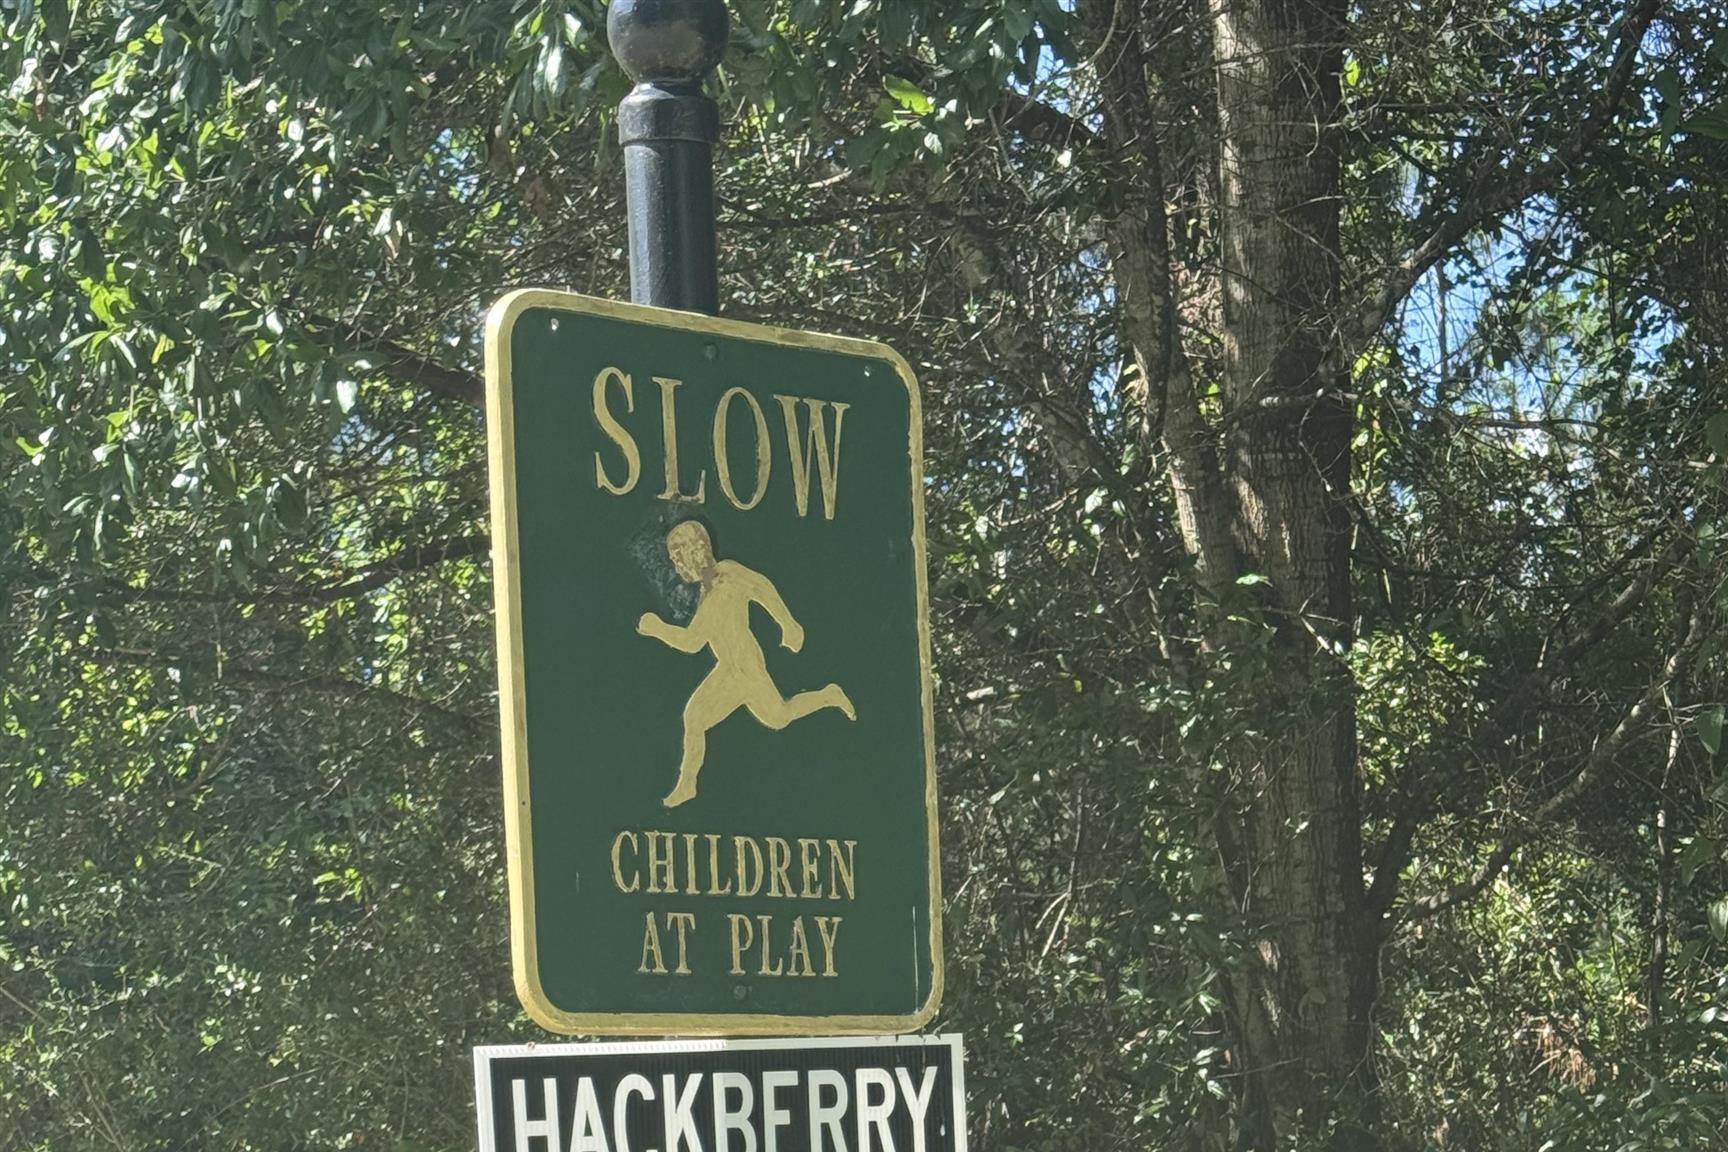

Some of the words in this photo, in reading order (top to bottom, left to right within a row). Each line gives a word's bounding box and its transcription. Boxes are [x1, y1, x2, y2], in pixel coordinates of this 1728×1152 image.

[592, 366, 851, 521] SLOW
[610, 830, 857, 900] CHILDREN
[638, 911, 696, 975] AT
[727, 913, 843, 977] PLAY
